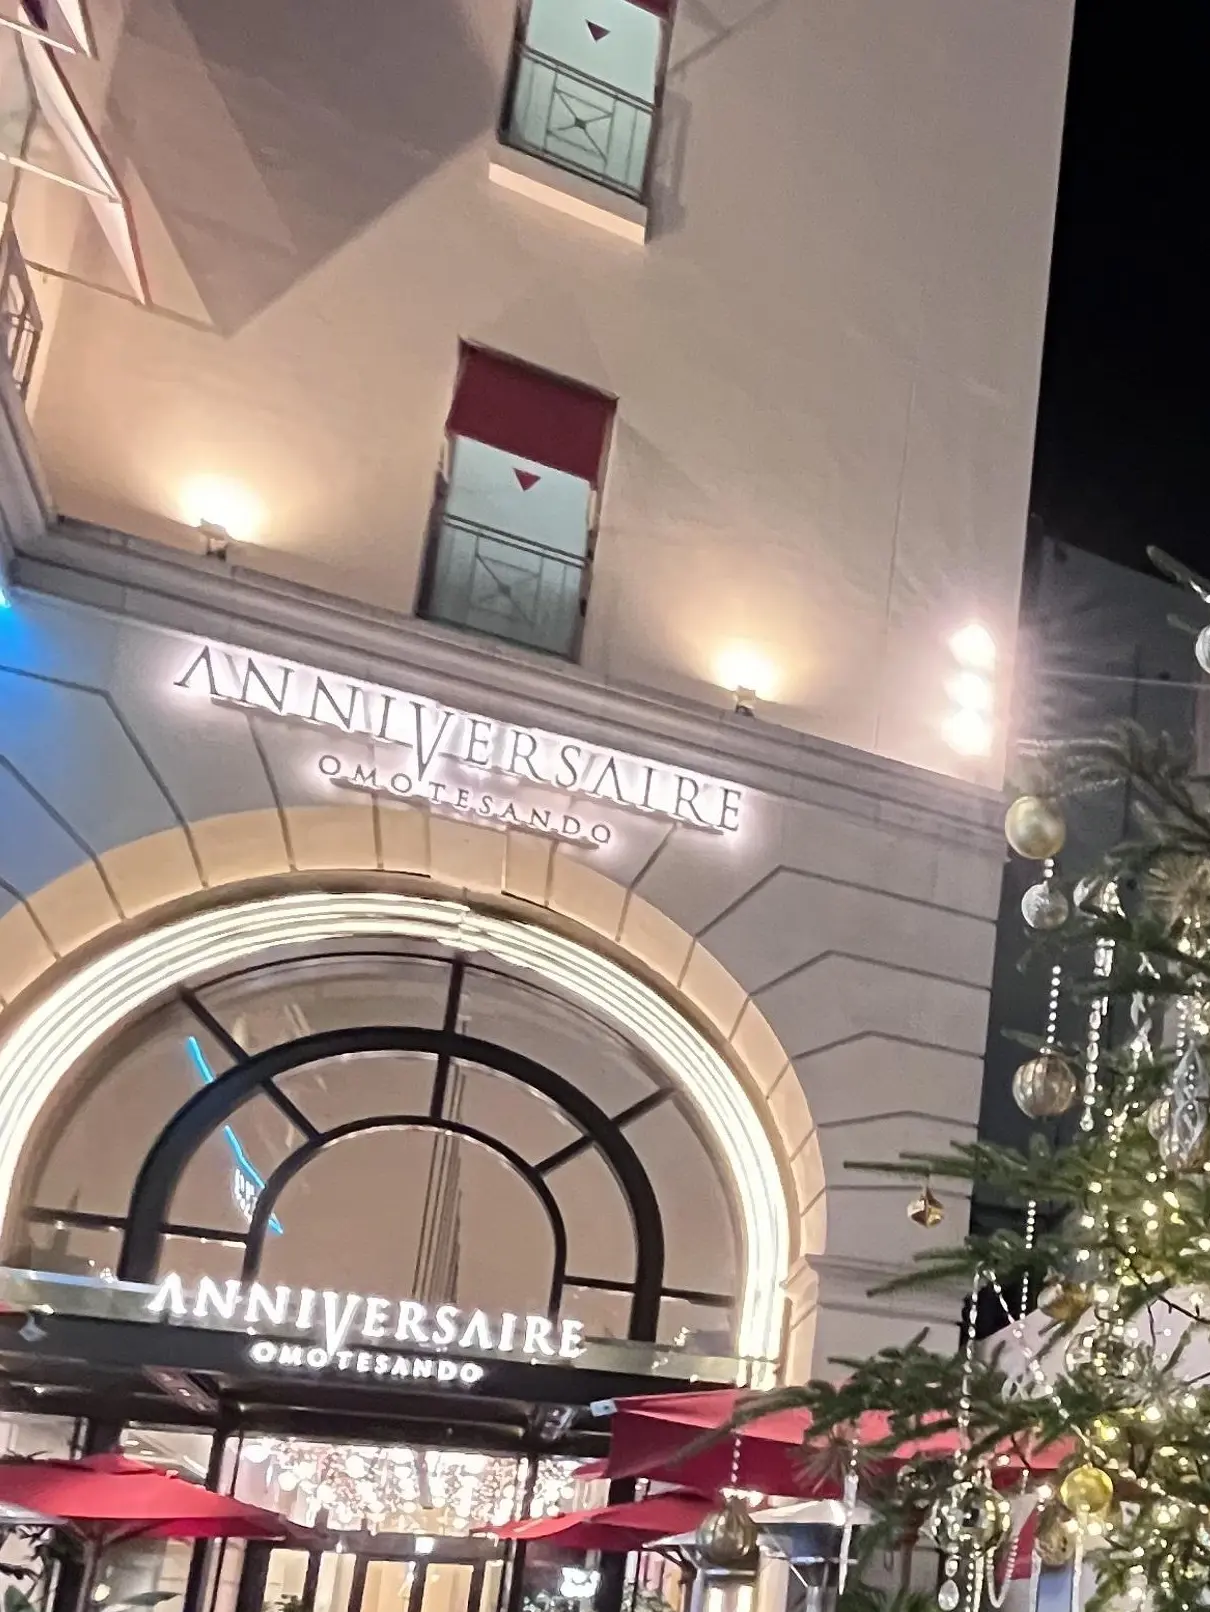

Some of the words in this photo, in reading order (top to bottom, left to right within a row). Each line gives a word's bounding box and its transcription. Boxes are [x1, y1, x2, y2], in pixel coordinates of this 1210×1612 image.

[173, 645, 743, 832] ANNIVERSAIRE
[318, 754, 612, 845] OMOTESANDO
[147, 1271, 588, 1359] ANNIVERSAIRE
[251, 1340, 484, 1384] OMOTESANDO
